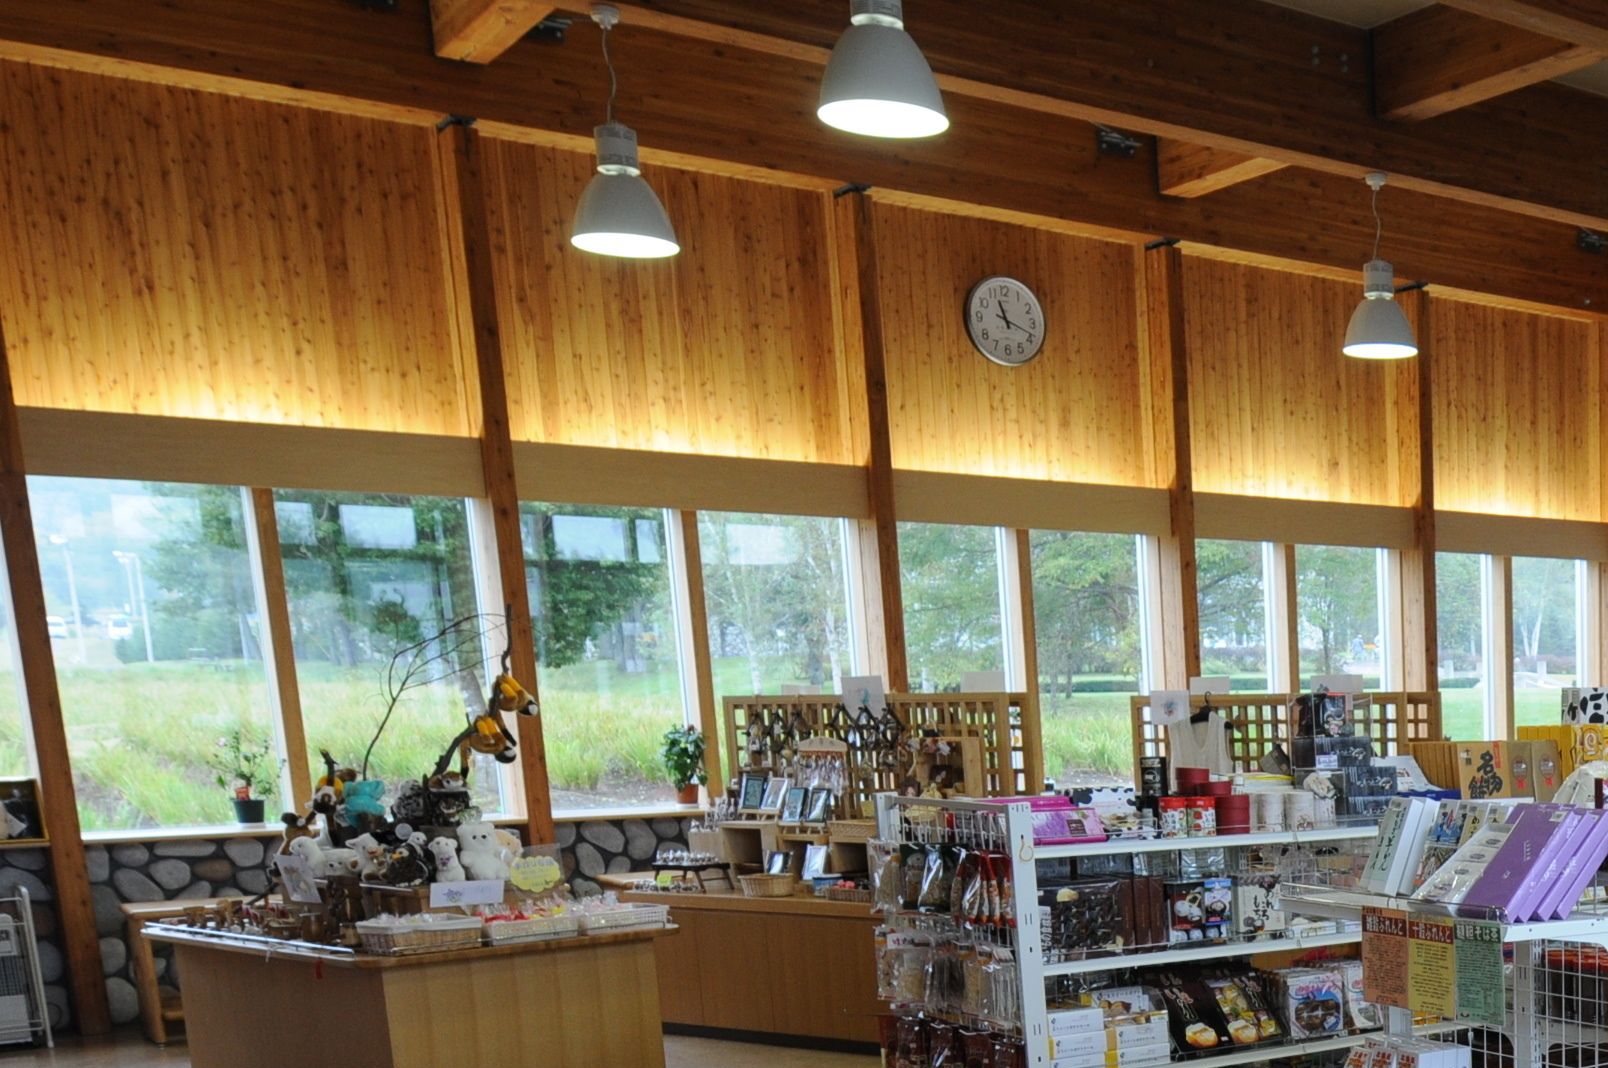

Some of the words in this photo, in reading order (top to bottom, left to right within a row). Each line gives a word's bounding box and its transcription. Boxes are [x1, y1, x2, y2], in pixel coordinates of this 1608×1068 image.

[989, 288, 997, 299] 11
[1000, 285, 1009, 297] 12
[1016, 291, 1020, 302] 1
[979, 297, 989, 309] 10
[1024, 303, 1032, 314] 2
[975, 310, 983, 322] 9
[1029, 318, 1036, 329] 3
[981, 328, 989, 340] 8
[992, 339, 999, 351] 7
[1004, 344, 1012, 356] 6
[1017, 342, 1025, 354] 5
